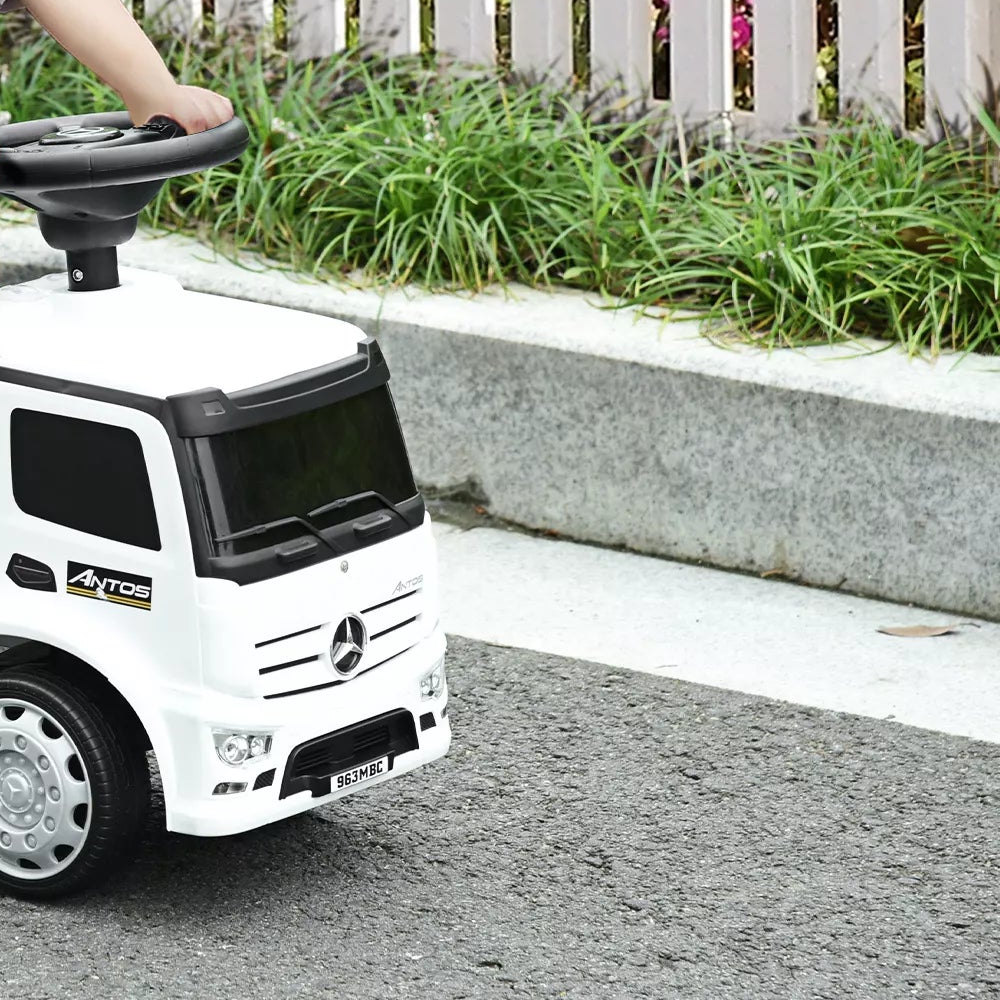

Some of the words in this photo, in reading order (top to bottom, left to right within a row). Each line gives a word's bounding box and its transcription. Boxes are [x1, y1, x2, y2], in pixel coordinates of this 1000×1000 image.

[68, 568, 151, 599] ANTOS
[392, 574, 423, 595] ANTOS
[337, 760, 383, 788] 963MBC
